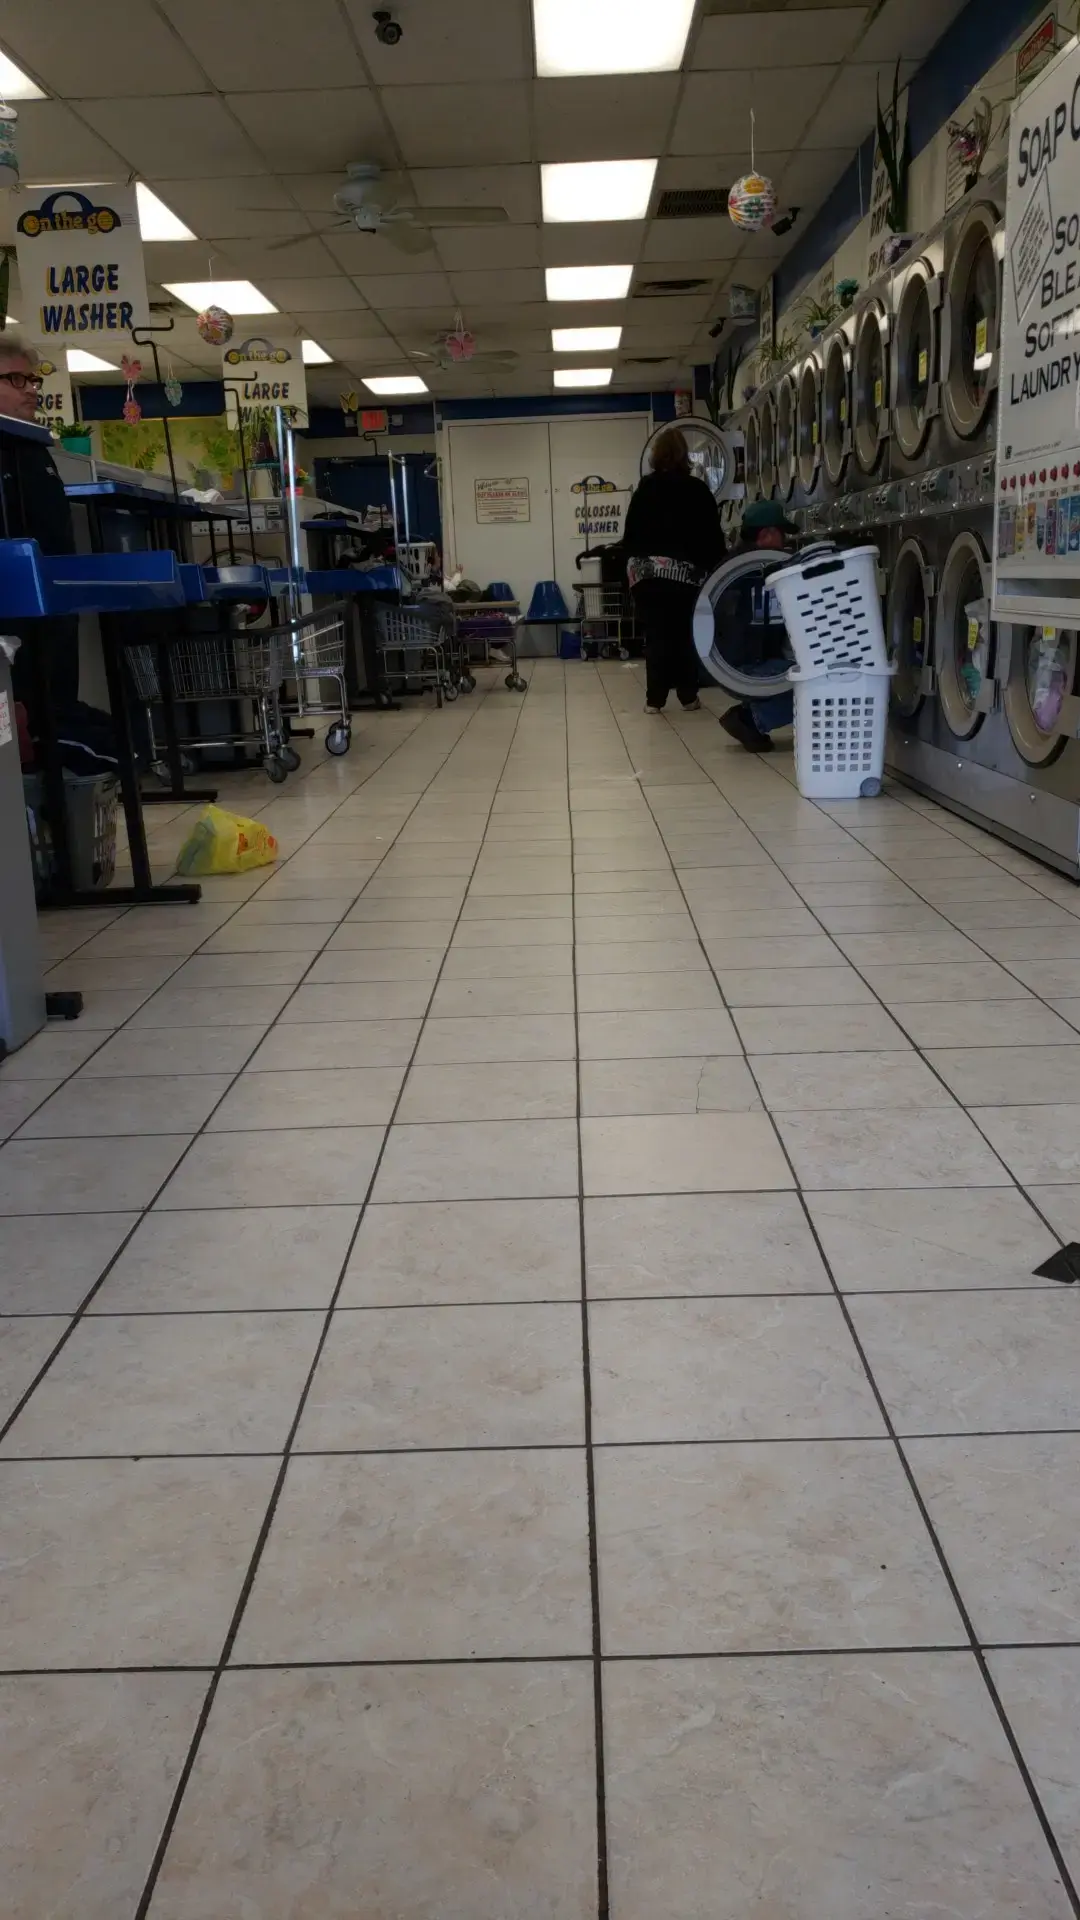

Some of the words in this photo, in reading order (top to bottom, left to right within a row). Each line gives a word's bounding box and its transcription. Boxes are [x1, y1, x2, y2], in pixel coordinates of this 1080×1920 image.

[1017, 102, 1067, 188] SOAP
[23, 213, 51, 236] On
[55, 209, 83, 231] the
[87, 210, 114, 235] go
[1054, 213, 1080, 256] SO
[46, 263, 119, 297] LARGE
[40, 301, 134, 335] WASHER
[243, 382, 290, 400] LARGE
[1010, 351, 1080, 406] LAUNDRY
[36, 393, 63, 410] RGE
[575, 504, 621, 518] COLOSSAL
[578, 520, 619, 534] WASHER
